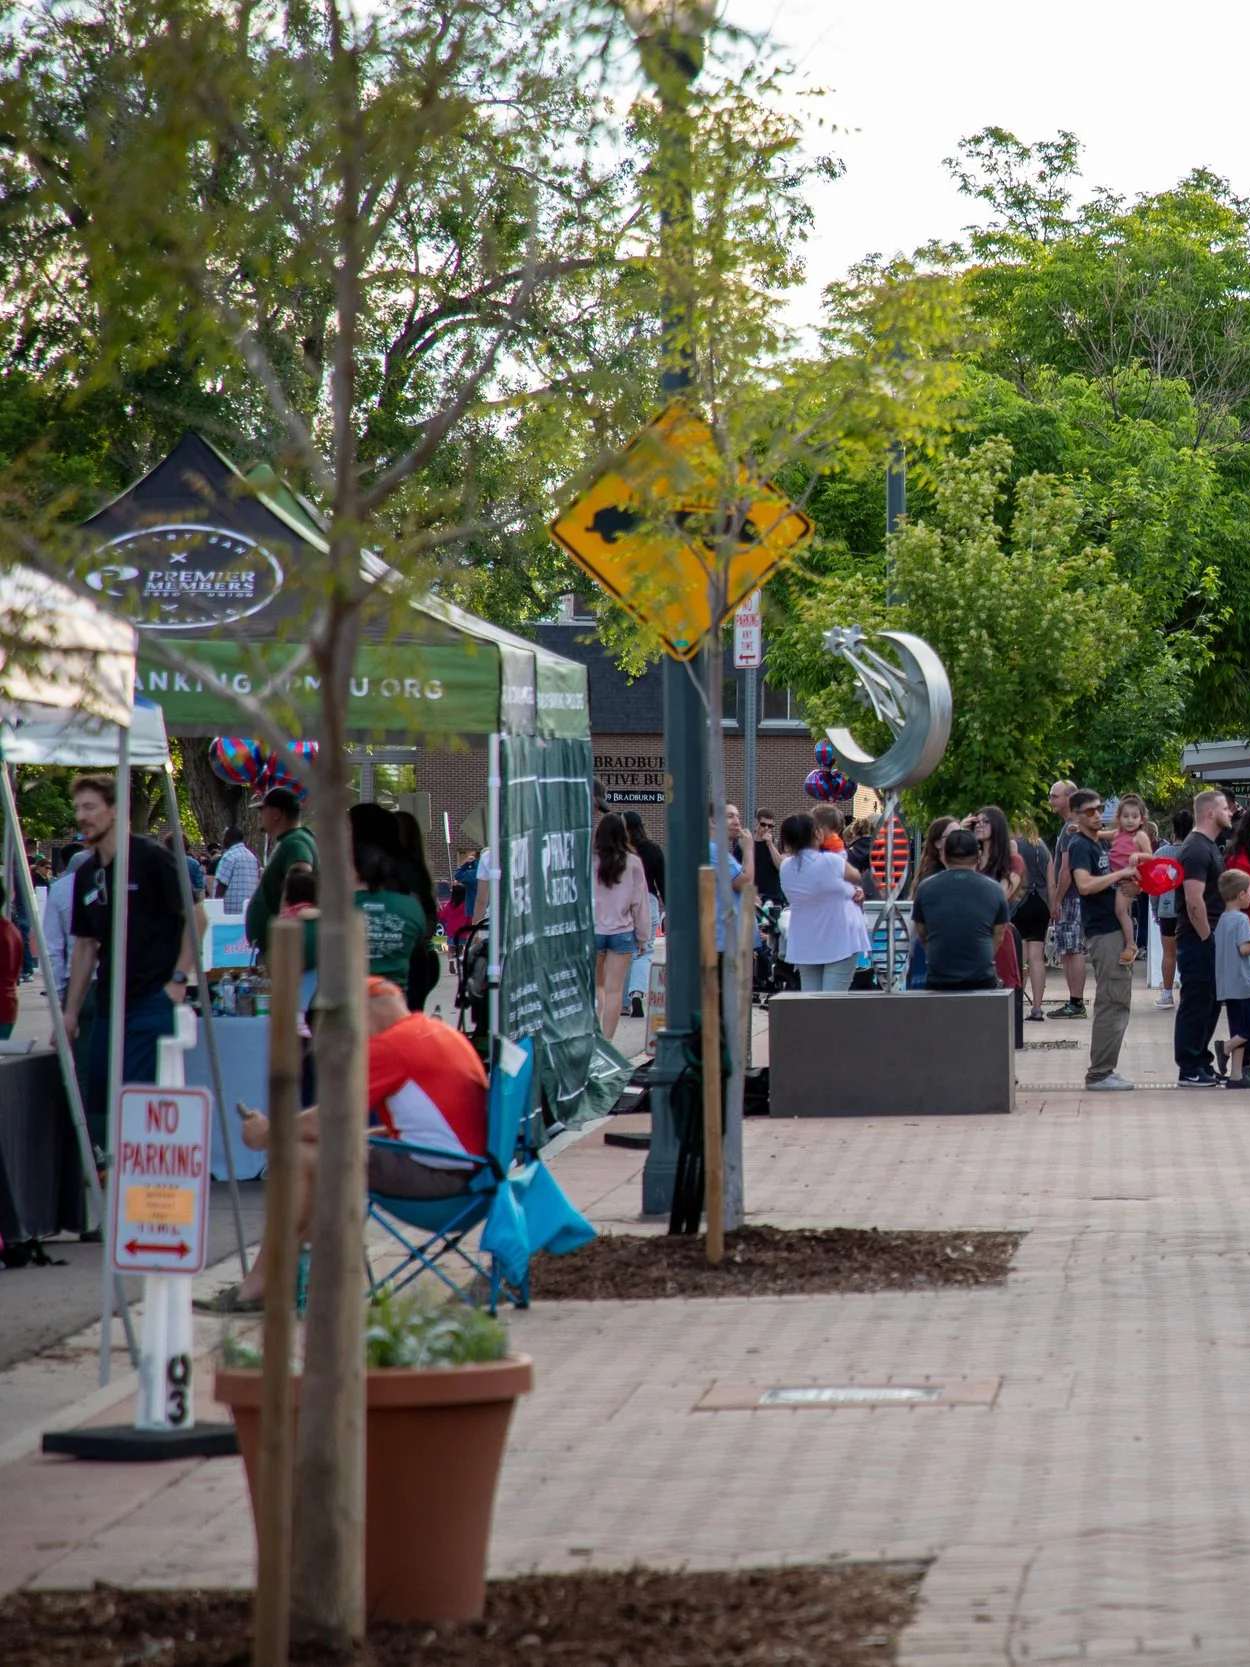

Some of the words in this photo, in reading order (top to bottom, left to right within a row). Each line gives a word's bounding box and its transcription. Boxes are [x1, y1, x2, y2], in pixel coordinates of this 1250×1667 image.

[148, 571, 255, 582] PREMIER
[145, 582, 255, 590] MEMBERS
[736, 613, 759, 626] PARKING
[742, 630, 752, 640] ANY
[741, 641, 753, 651] TIME
[146, 1100, 179, 1134] NO
[122, 1142, 203, 1178] PARKING
